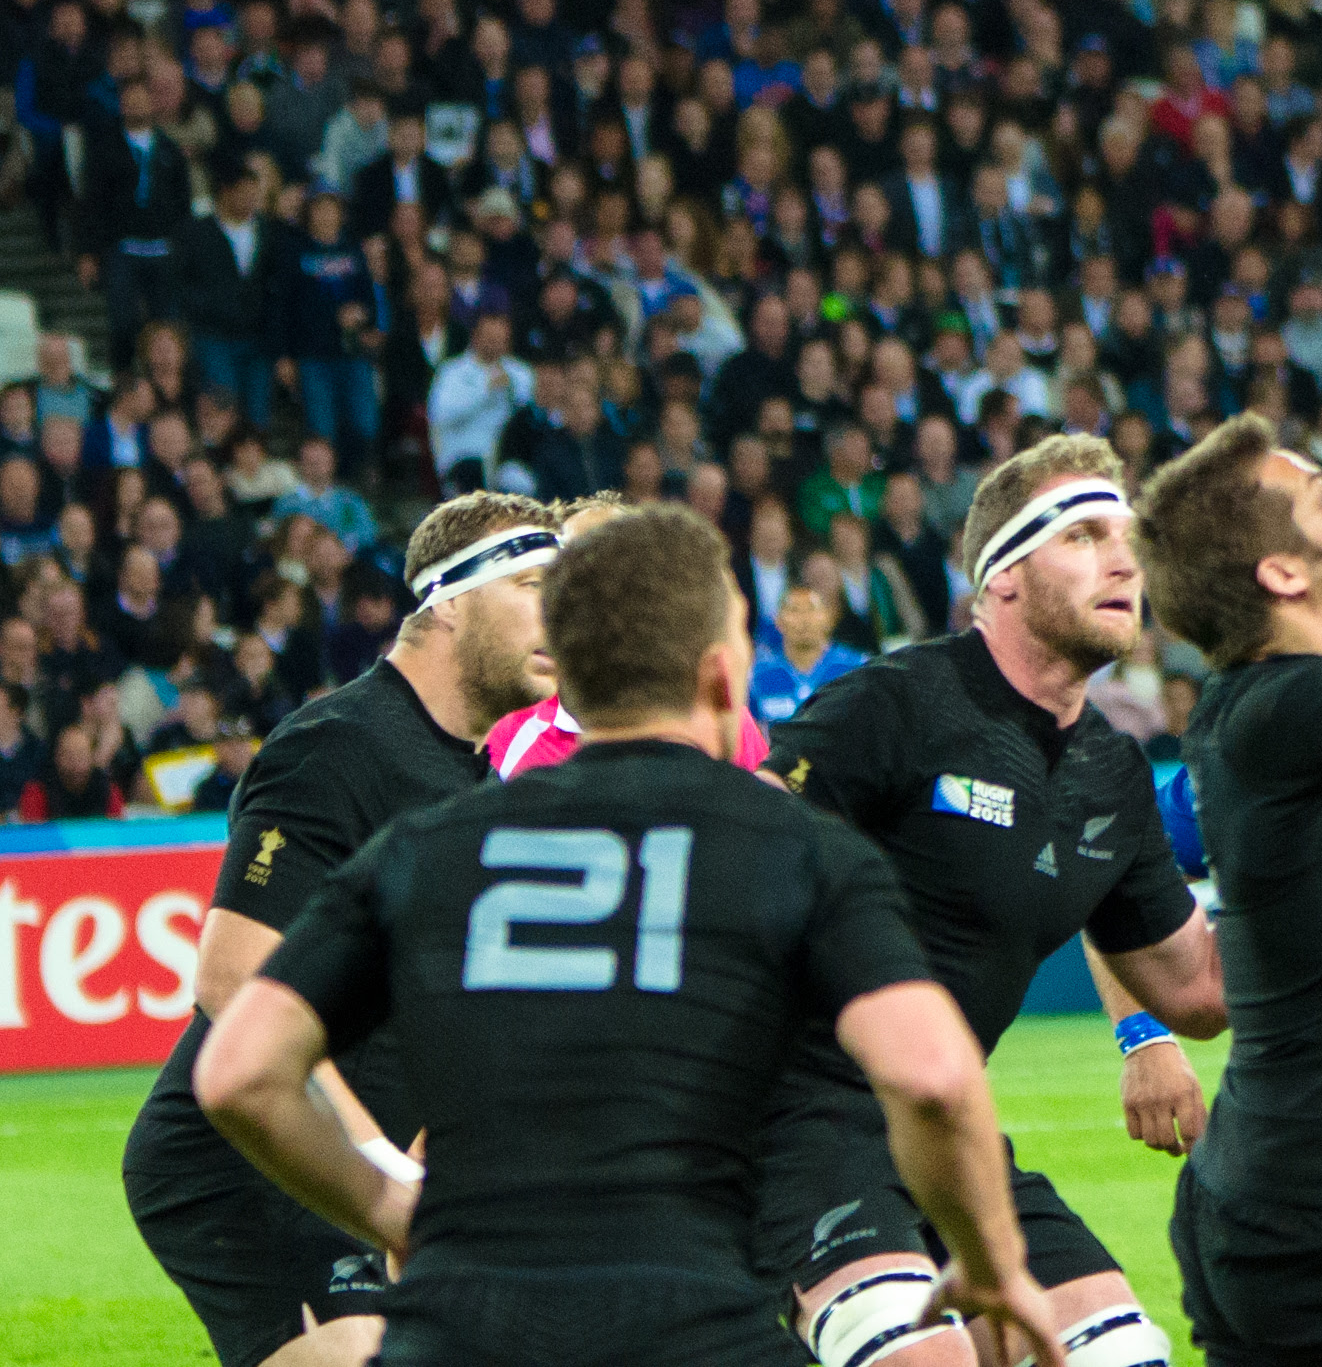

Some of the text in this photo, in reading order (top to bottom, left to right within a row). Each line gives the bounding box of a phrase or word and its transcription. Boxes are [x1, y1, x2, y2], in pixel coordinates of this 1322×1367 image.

[972, 779, 1015, 804] RUGBY
[969, 803, 1014, 828] 2015
[461, 824, 694, 994] 21
